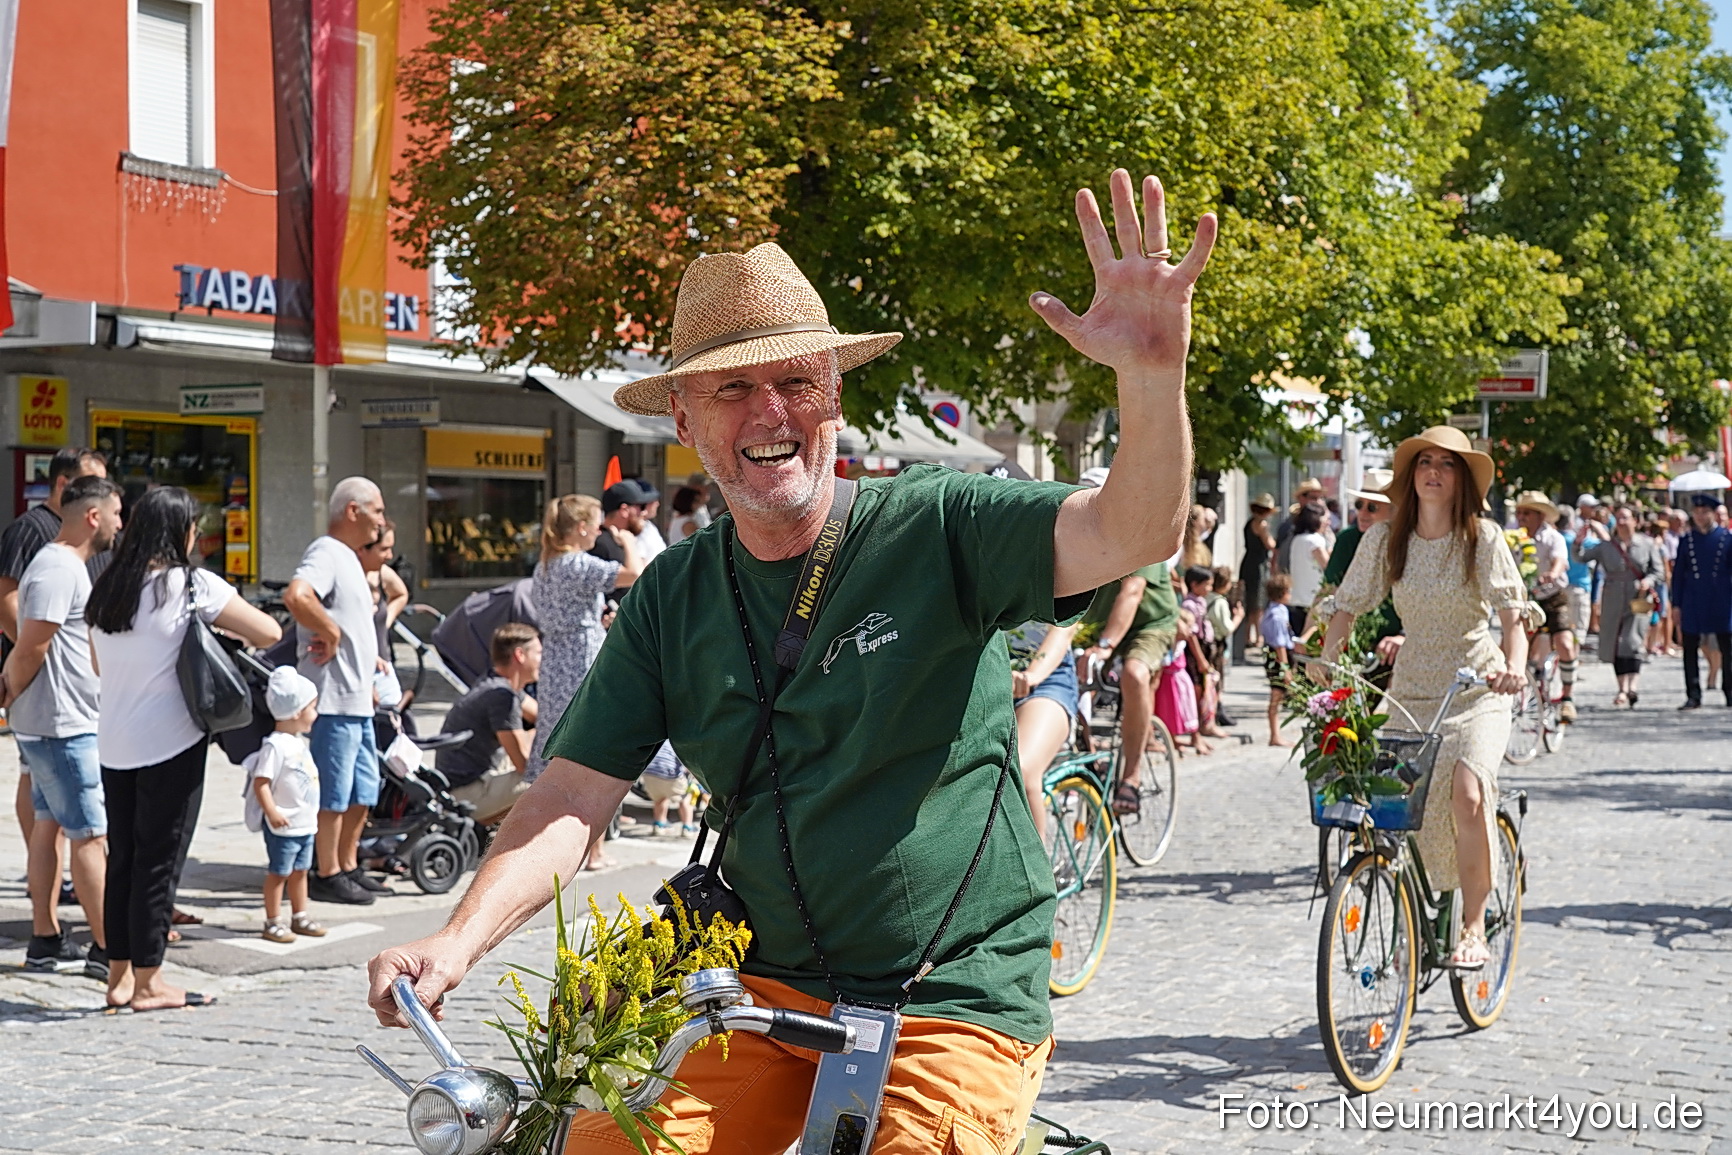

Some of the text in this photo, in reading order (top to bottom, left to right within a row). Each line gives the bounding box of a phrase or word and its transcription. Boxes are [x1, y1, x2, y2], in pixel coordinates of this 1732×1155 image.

[174, 264, 419, 332] TABAKAREN
[184, 393, 209, 409] NZ
[24, 413, 63, 430] LOTTO
[796, 518, 842, 620] Nikon D300s
[855, 629, 899, 656] Express
